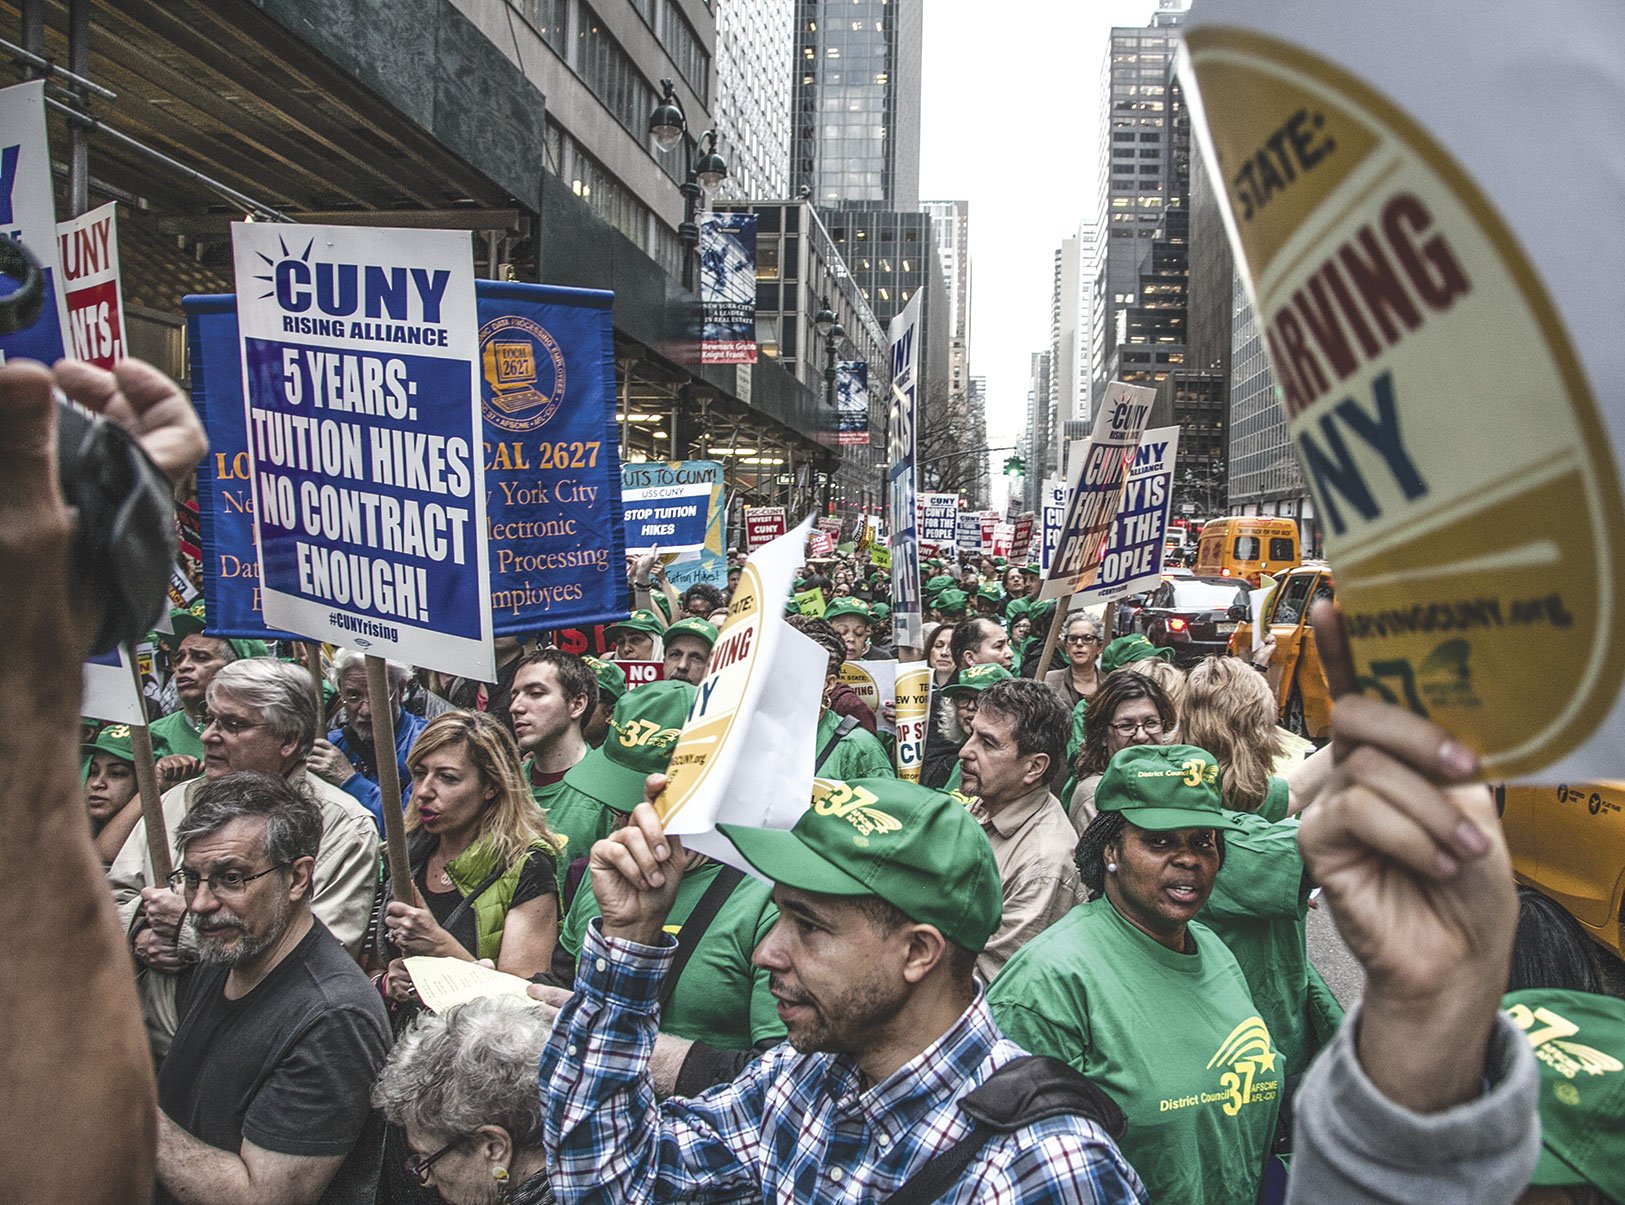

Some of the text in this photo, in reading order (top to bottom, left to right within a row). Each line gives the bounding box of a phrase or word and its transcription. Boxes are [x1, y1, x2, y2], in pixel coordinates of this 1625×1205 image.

[1233, 107, 1337, 222] STATE:
[57, 215, 111, 282] UNY
[275, 259, 451, 324] CUNY
[71, 301, 122, 362] NTS,
[282, 315, 449, 347] RISING ALLIANCE
[502, 348, 528, 359] LOCAL
[503, 359, 529, 376] 2627
[701, 349, 745, 360] Knight Frank
[282, 347, 418, 421] 5 YEARS:
[251, 407, 471, 498] TUITION HIKES
[539, 441, 601, 470] 2627
[1135, 441, 1169, 467] NY
[1297, 368, 1429, 538] NY
[623, 467, 717, 487] UTS TO CUNY!
[498, 479, 598, 509] York City
[641, 487, 685, 499] USS CUNY
[1143, 474, 1166, 511] IS
[260, 471, 469, 565] NO CONTRACT
[624, 504, 698, 521] STOP TUITION
[925, 507, 955, 517] CUNY IS
[925, 518, 955, 529] FOR THE
[1069, 491, 1105, 530] FOR
[487, 512, 577, 541] lectronic
[641, 523, 676, 536] HIKES
[754, 524, 779, 534] CUNY
[926, 529, 953, 539] PEOPLE
[1123, 508, 1163, 548] THE
[496, 543, 610, 573] Processing
[1093, 542, 1155, 587] EOPLE
[296, 541, 429, 623] ENOUGH!
[491, 580, 583, 616] mployees
[329, 611, 399, 643] #CUNYrising
[629, 665, 658, 682] NO
[896, 695, 910, 705] EW
[618, 718, 662, 748] 37
[896, 720, 911, 743] OP
[1137, 770, 1164, 778] District
[1165, 769, 1190, 777] Council
[1181, 758, 1207, 787] 37
[814, 783, 880, 818] 37
[1160, 1089, 1231, 1112] District Council
[1219, 1060, 1257, 1117] 37
[1250, 1080, 1278, 1093] AFSCME
[1250, 1091, 1277, 1104] AFL-CIO
